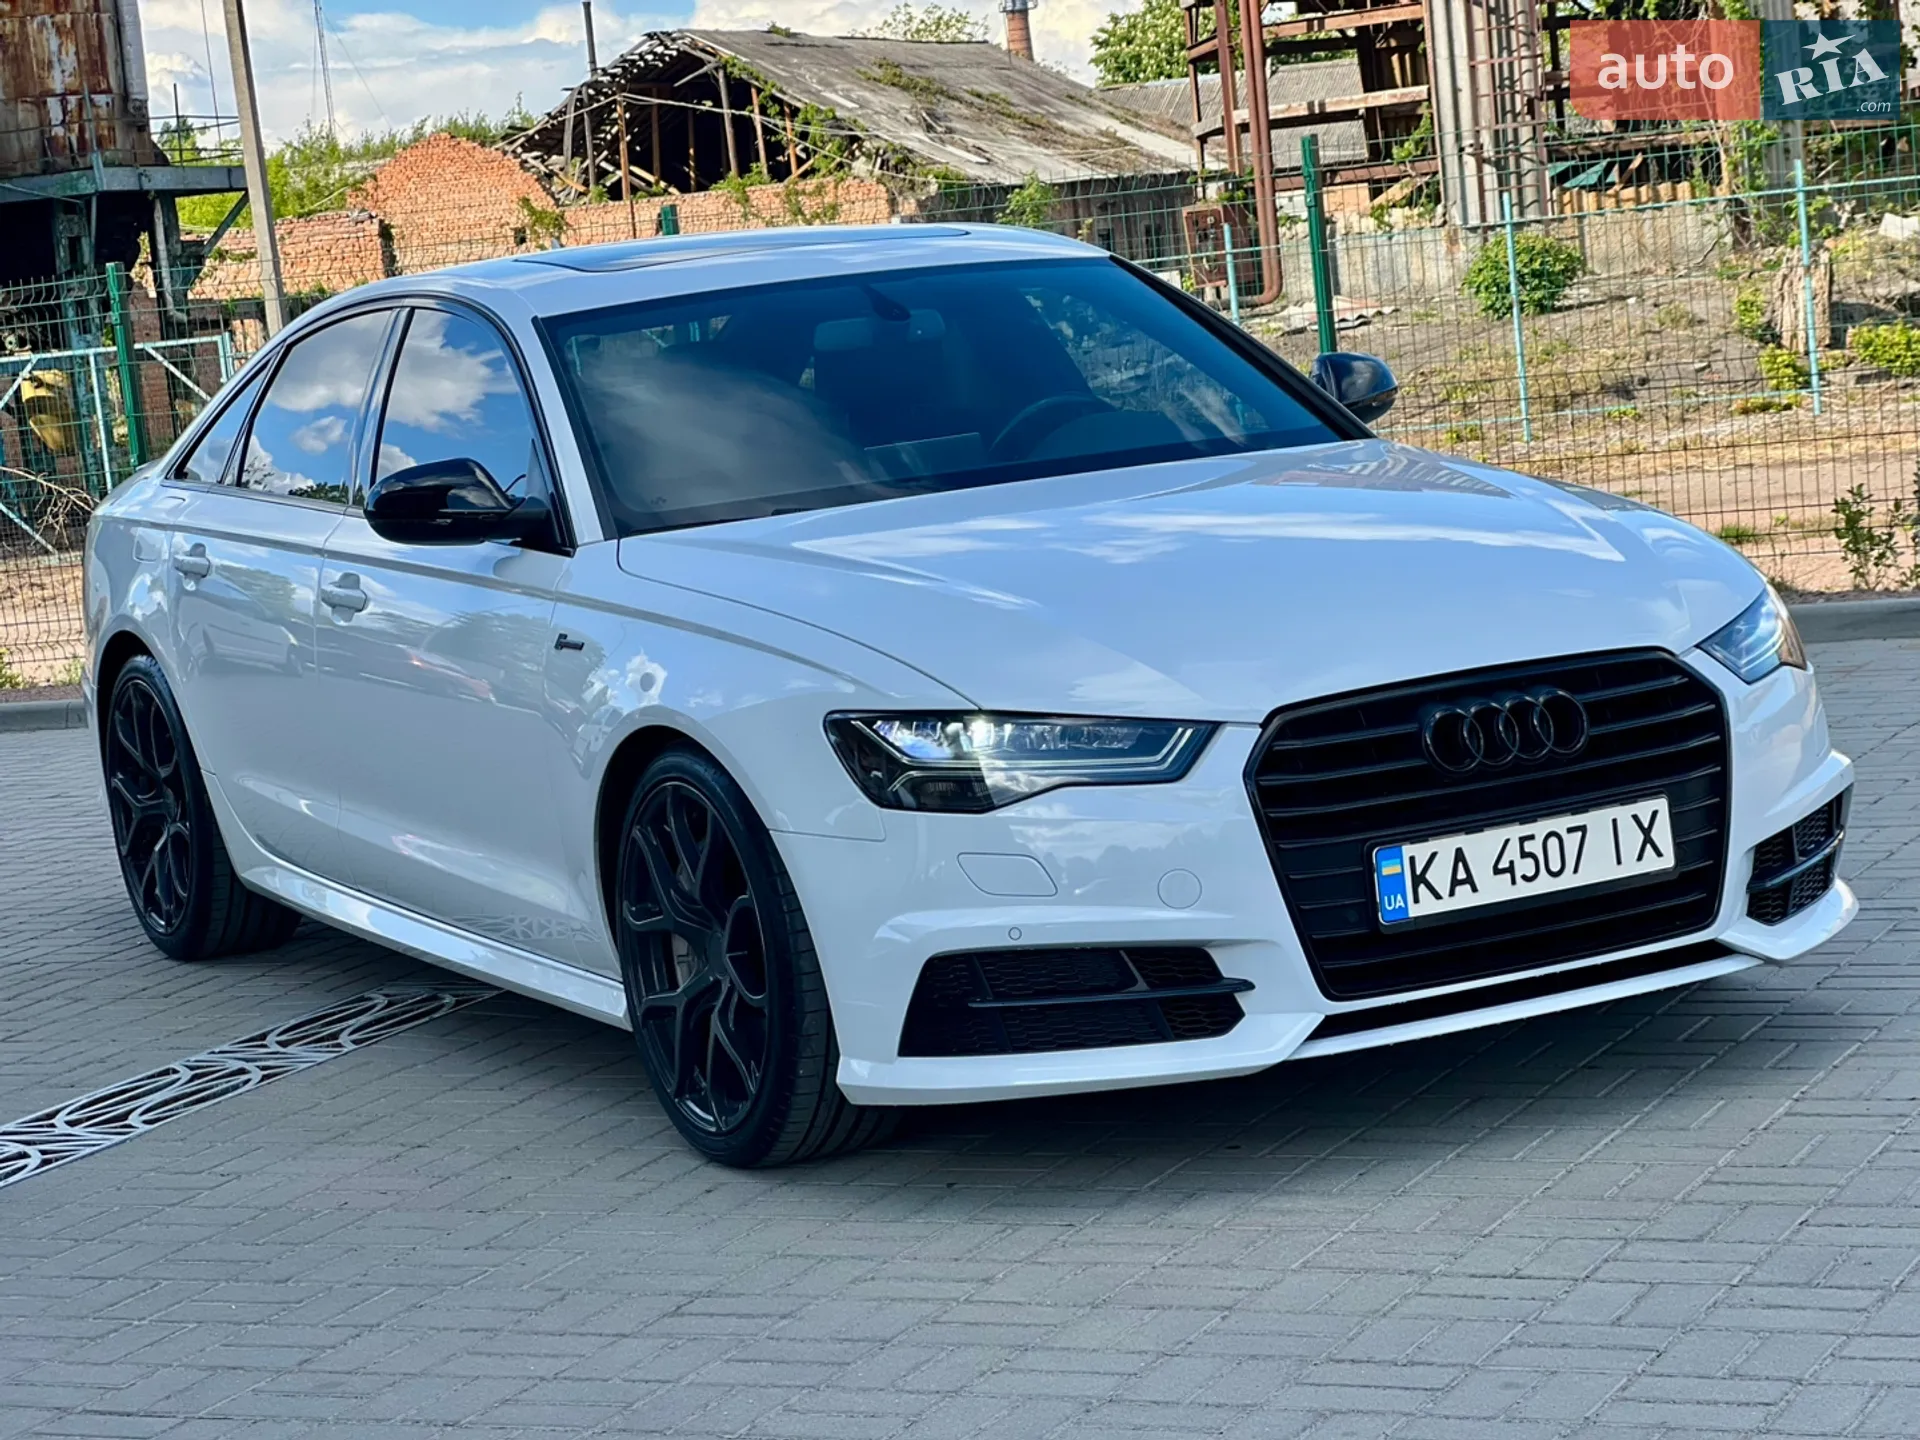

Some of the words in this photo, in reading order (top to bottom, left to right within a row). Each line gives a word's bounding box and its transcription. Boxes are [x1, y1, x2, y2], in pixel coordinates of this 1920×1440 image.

[1408, 847, 1479, 904] KA
[1492, 824, 1588, 886] 4507
[1611, 809, 1664, 866] IX
[1384, 893, 1406, 911] UA
